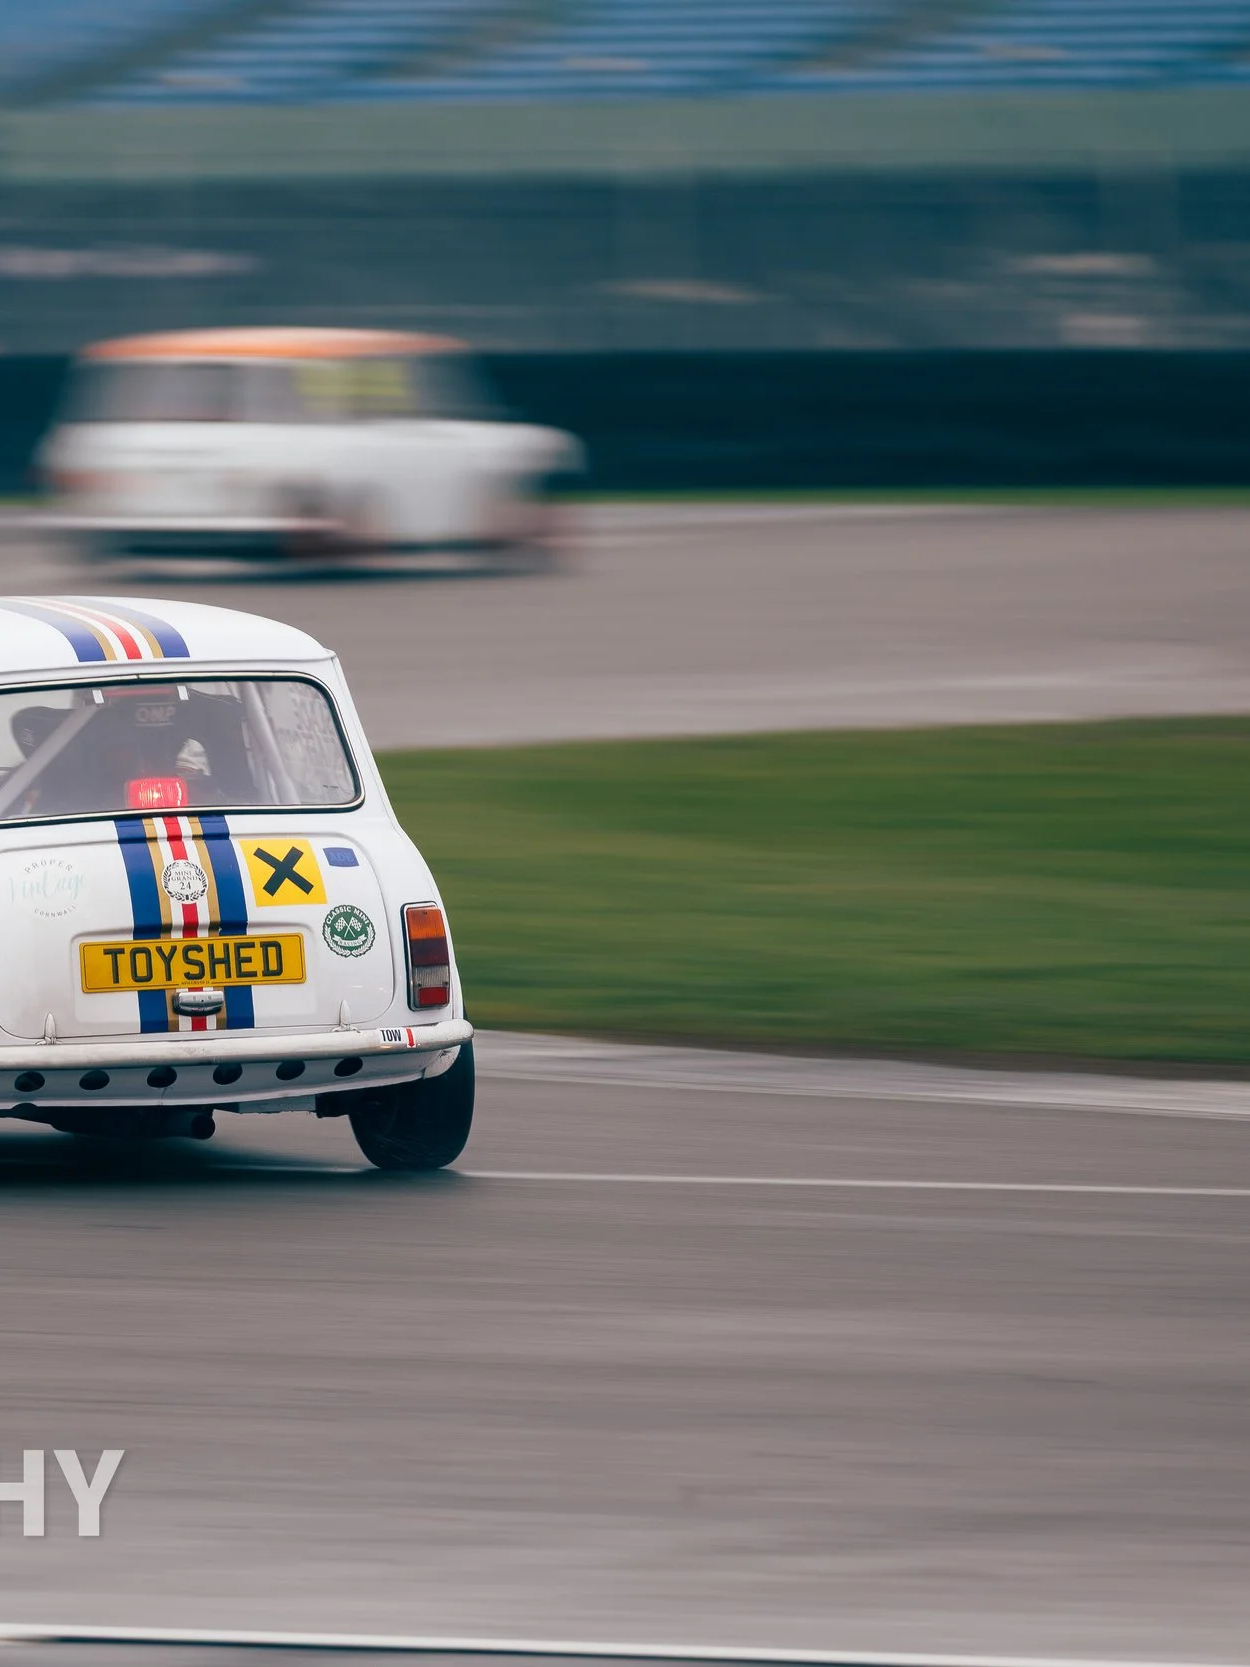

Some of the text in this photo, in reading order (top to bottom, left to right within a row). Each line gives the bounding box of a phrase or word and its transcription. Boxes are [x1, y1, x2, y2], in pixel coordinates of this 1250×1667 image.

[24, 859, 73, 874] PROPER
[180, 881, 191, 890] 24
[34, 903, 77, 918] CORNWALL
[326, 905, 370, 925] CLASSIC MINI
[103, 940, 283, 984] TOYSHED
[380, 1028, 402, 1042] TOW
